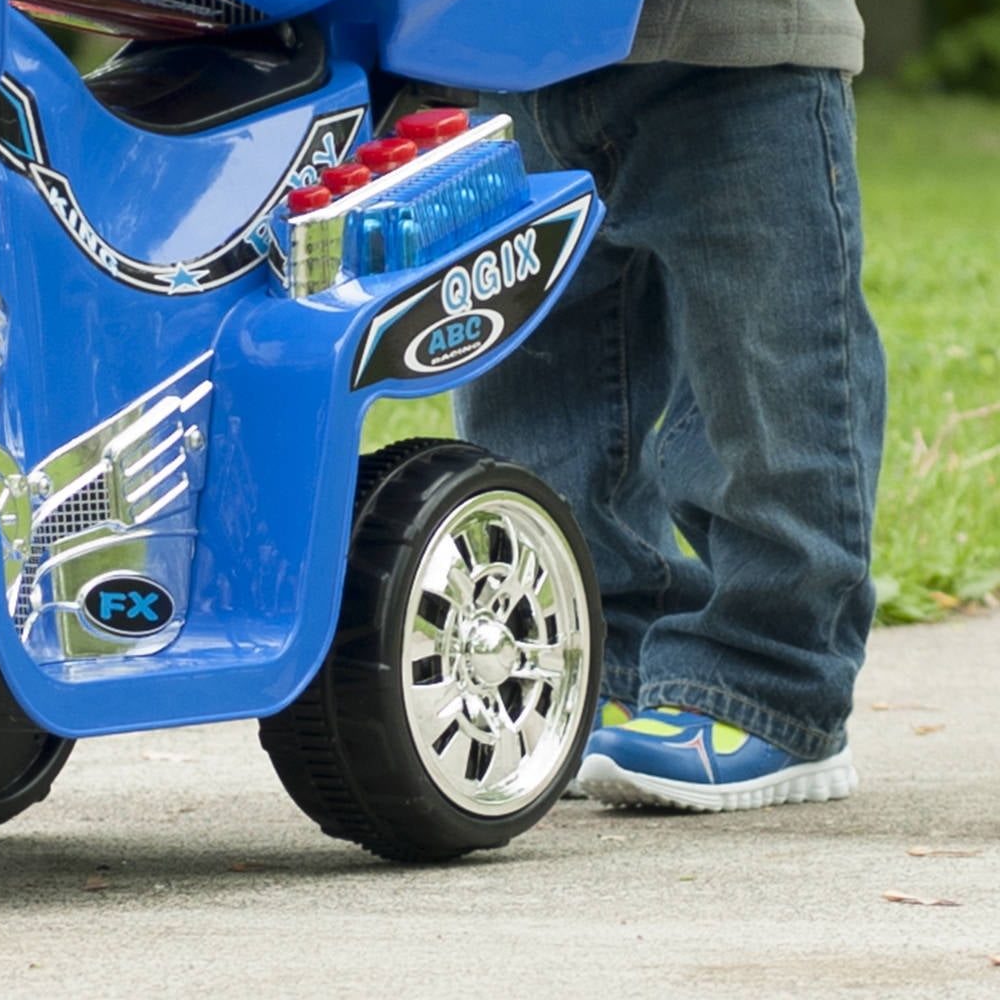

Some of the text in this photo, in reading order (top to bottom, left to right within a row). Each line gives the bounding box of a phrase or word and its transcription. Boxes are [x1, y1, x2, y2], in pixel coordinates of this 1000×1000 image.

[49, 186, 118, 277] KING
[441, 227, 541, 315] QGIX
[428, 315, 482, 356] ABC
[99, 591, 159, 621] FX
